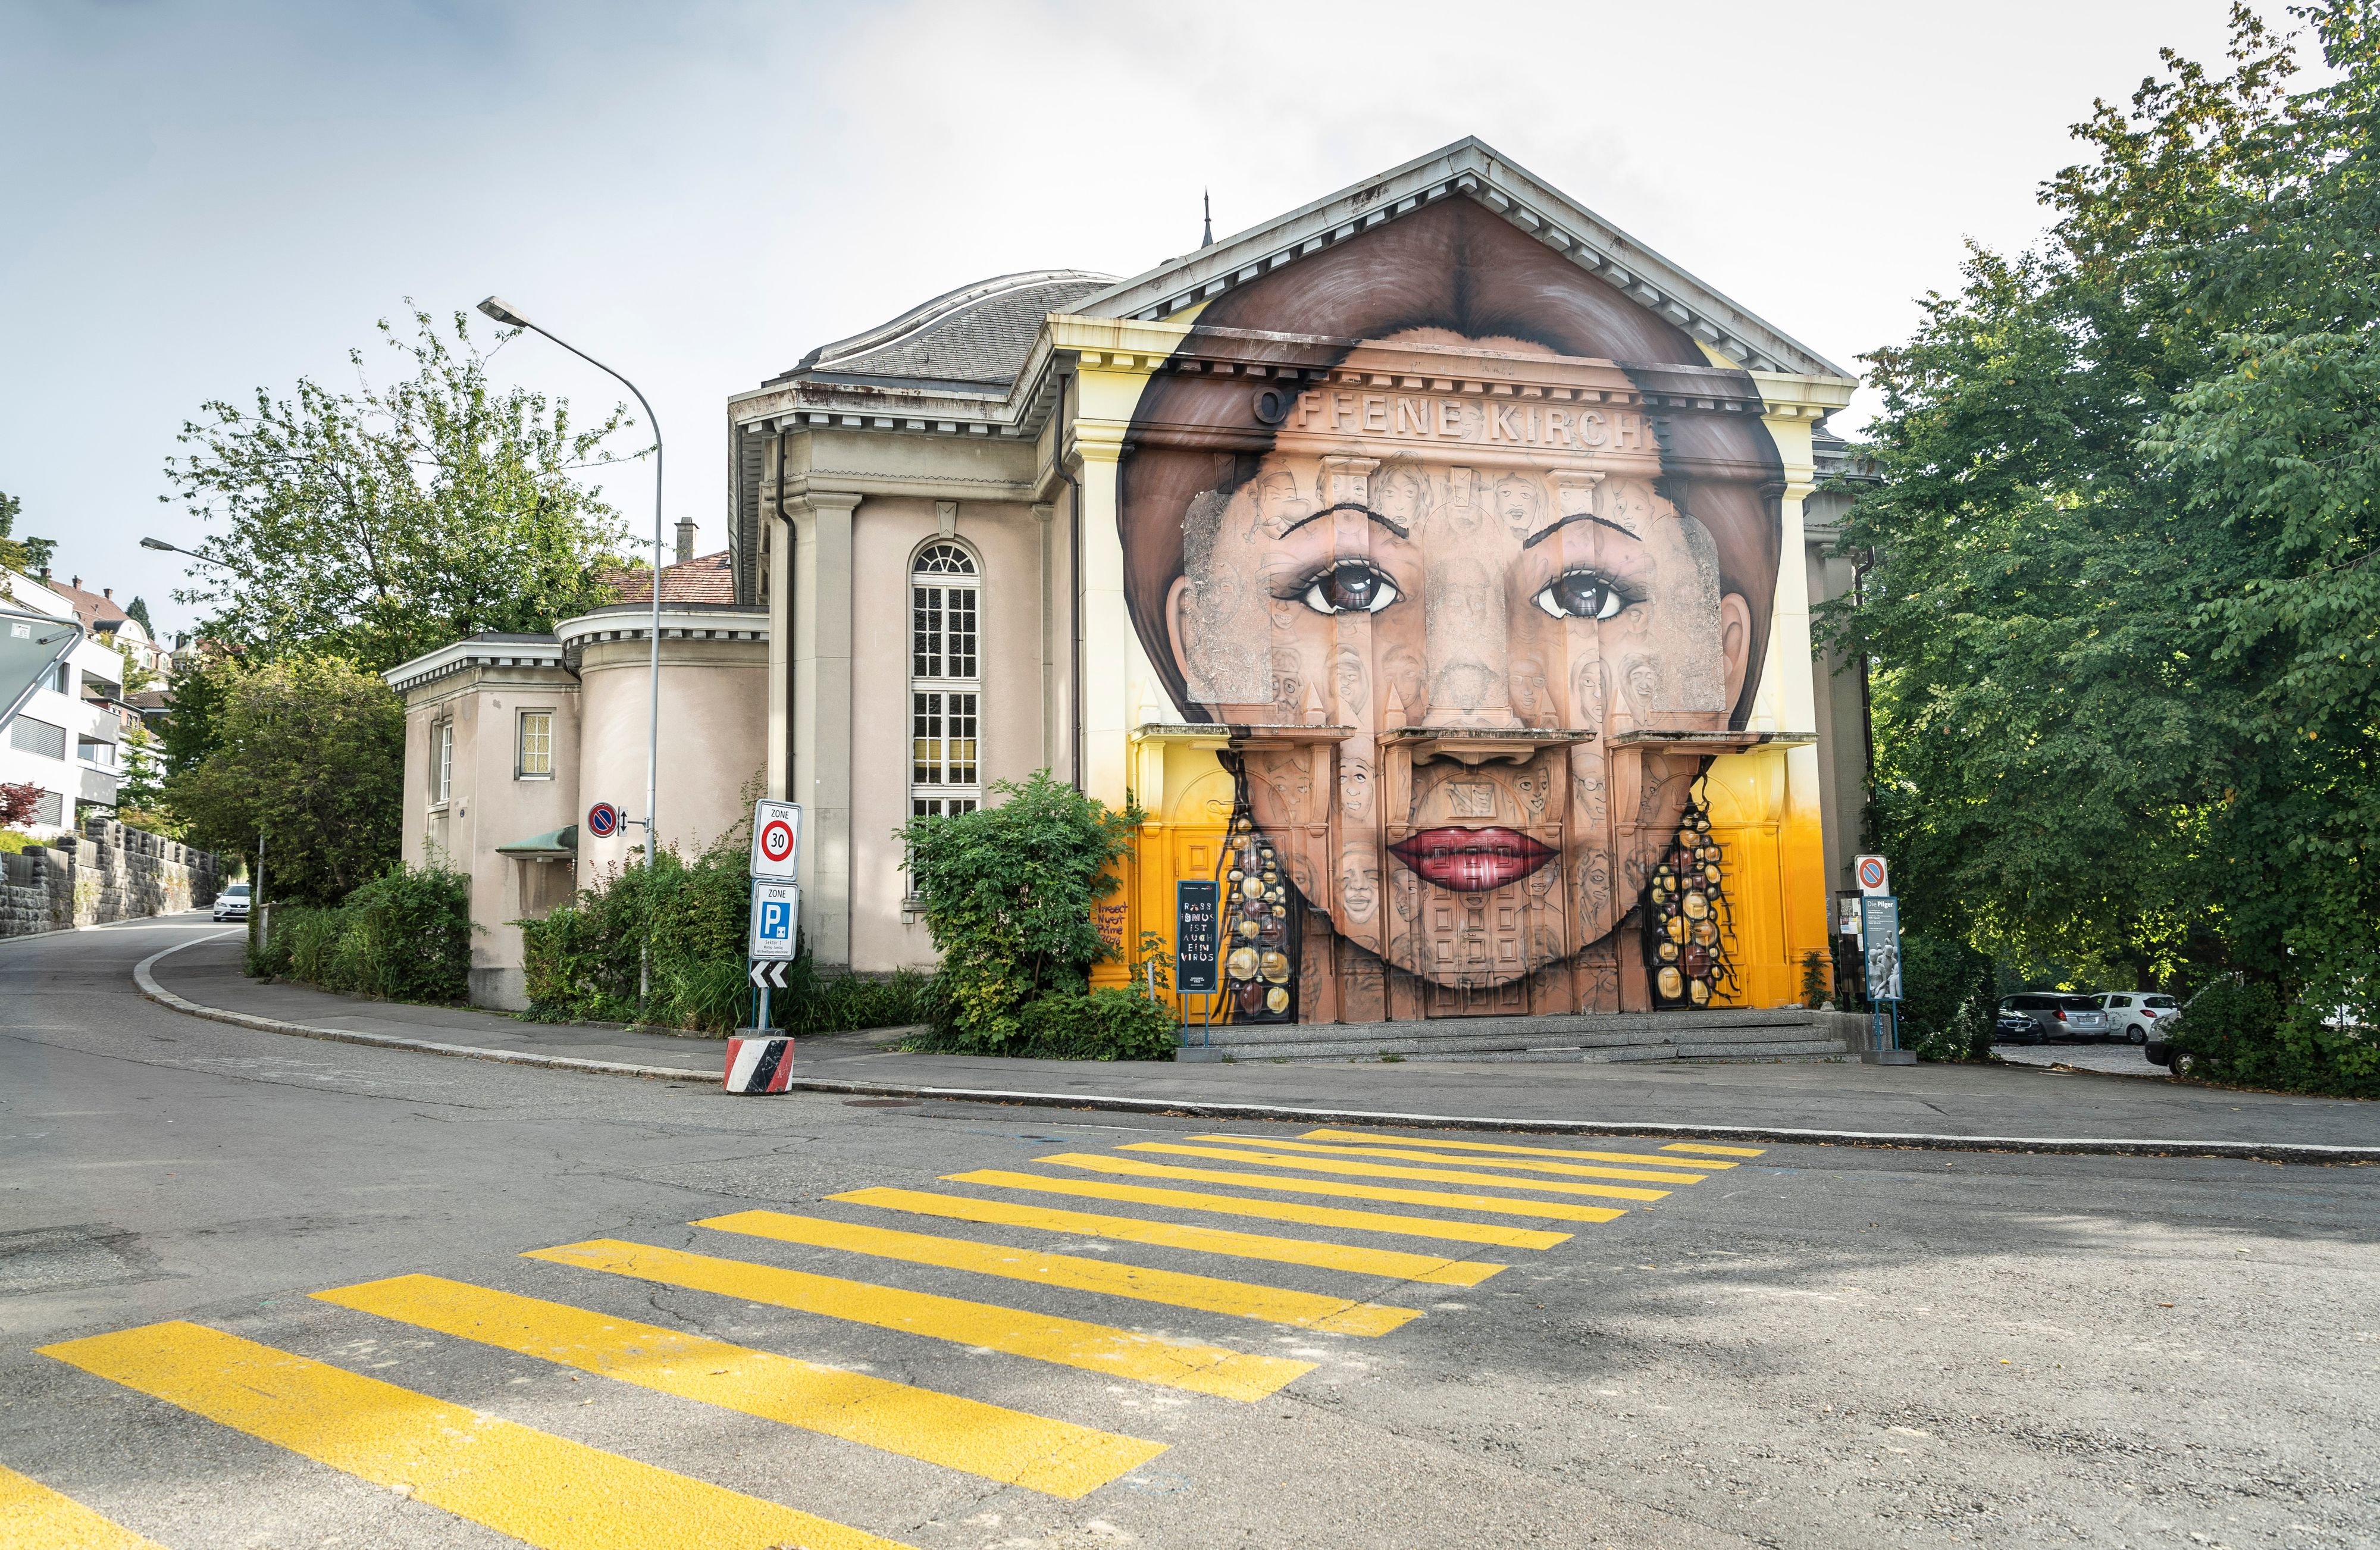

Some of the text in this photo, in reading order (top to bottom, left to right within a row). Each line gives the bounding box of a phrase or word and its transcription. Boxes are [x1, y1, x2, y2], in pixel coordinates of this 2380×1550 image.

[1252, 387, 1671, 450] OFFENE KIRCHE
[771, 809, 789, 819] ZONE
[771, 832, 785, 848] 30
[768, 889, 786, 898] ZONE
[1184, 902, 1211, 911] RASS
[1877, 900, 1894, 909] Pilger
[765, 904, 781, 934] P
[1095, 923, 1123, 935] Prime
[1183, 934, 1213, 942] AUCH
[1180, 952, 1214, 962] VIRUS
